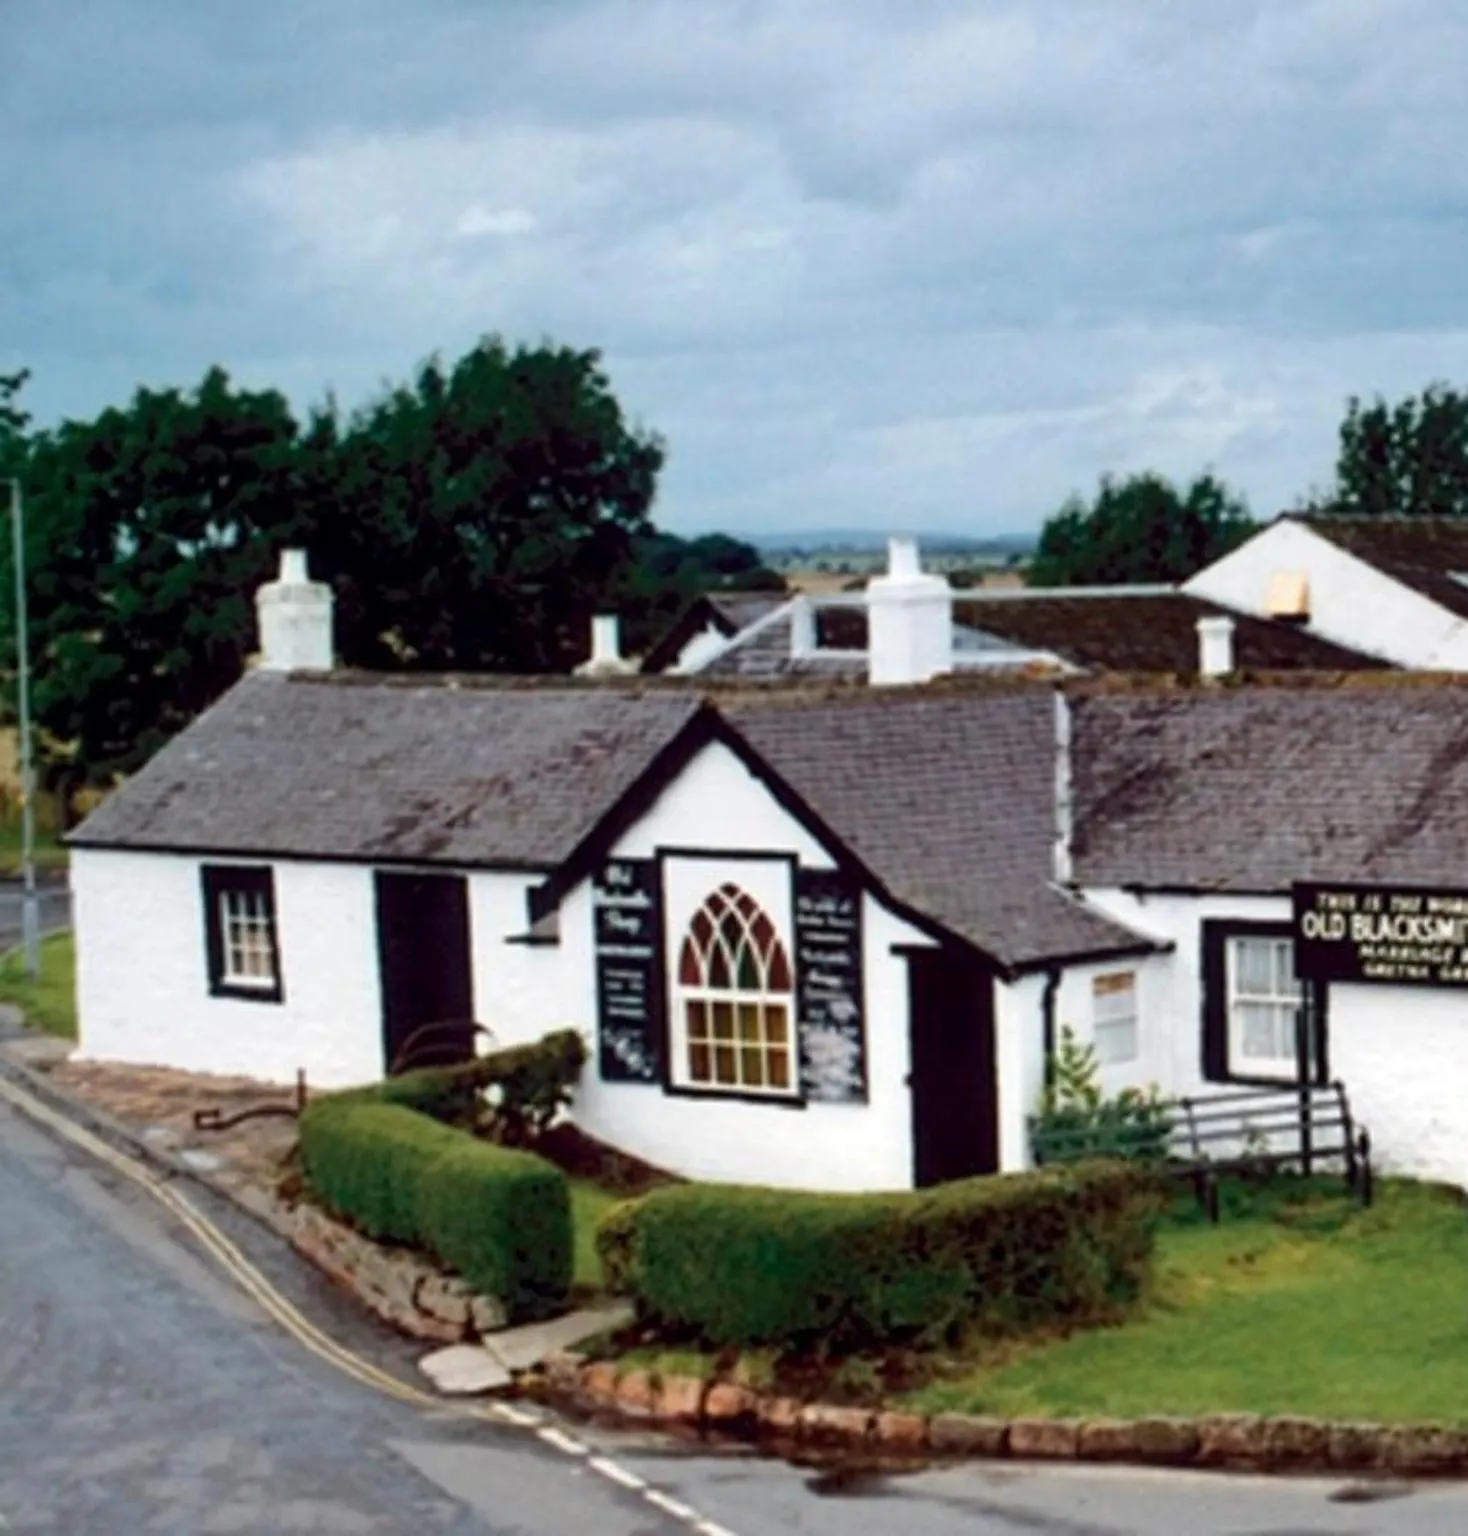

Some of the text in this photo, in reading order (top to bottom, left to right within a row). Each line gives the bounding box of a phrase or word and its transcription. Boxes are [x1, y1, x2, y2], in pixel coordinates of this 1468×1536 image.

[1316, 892, 1356, 911] THIS
[1363, 893, 1382, 911] IS
[1389, 894, 1421, 913] THE
[1301, 910, 1346, 940] OLD
[1358, 944, 1455, 964] MARRIAGE
[1362, 962, 1430, 979] GRETNA
